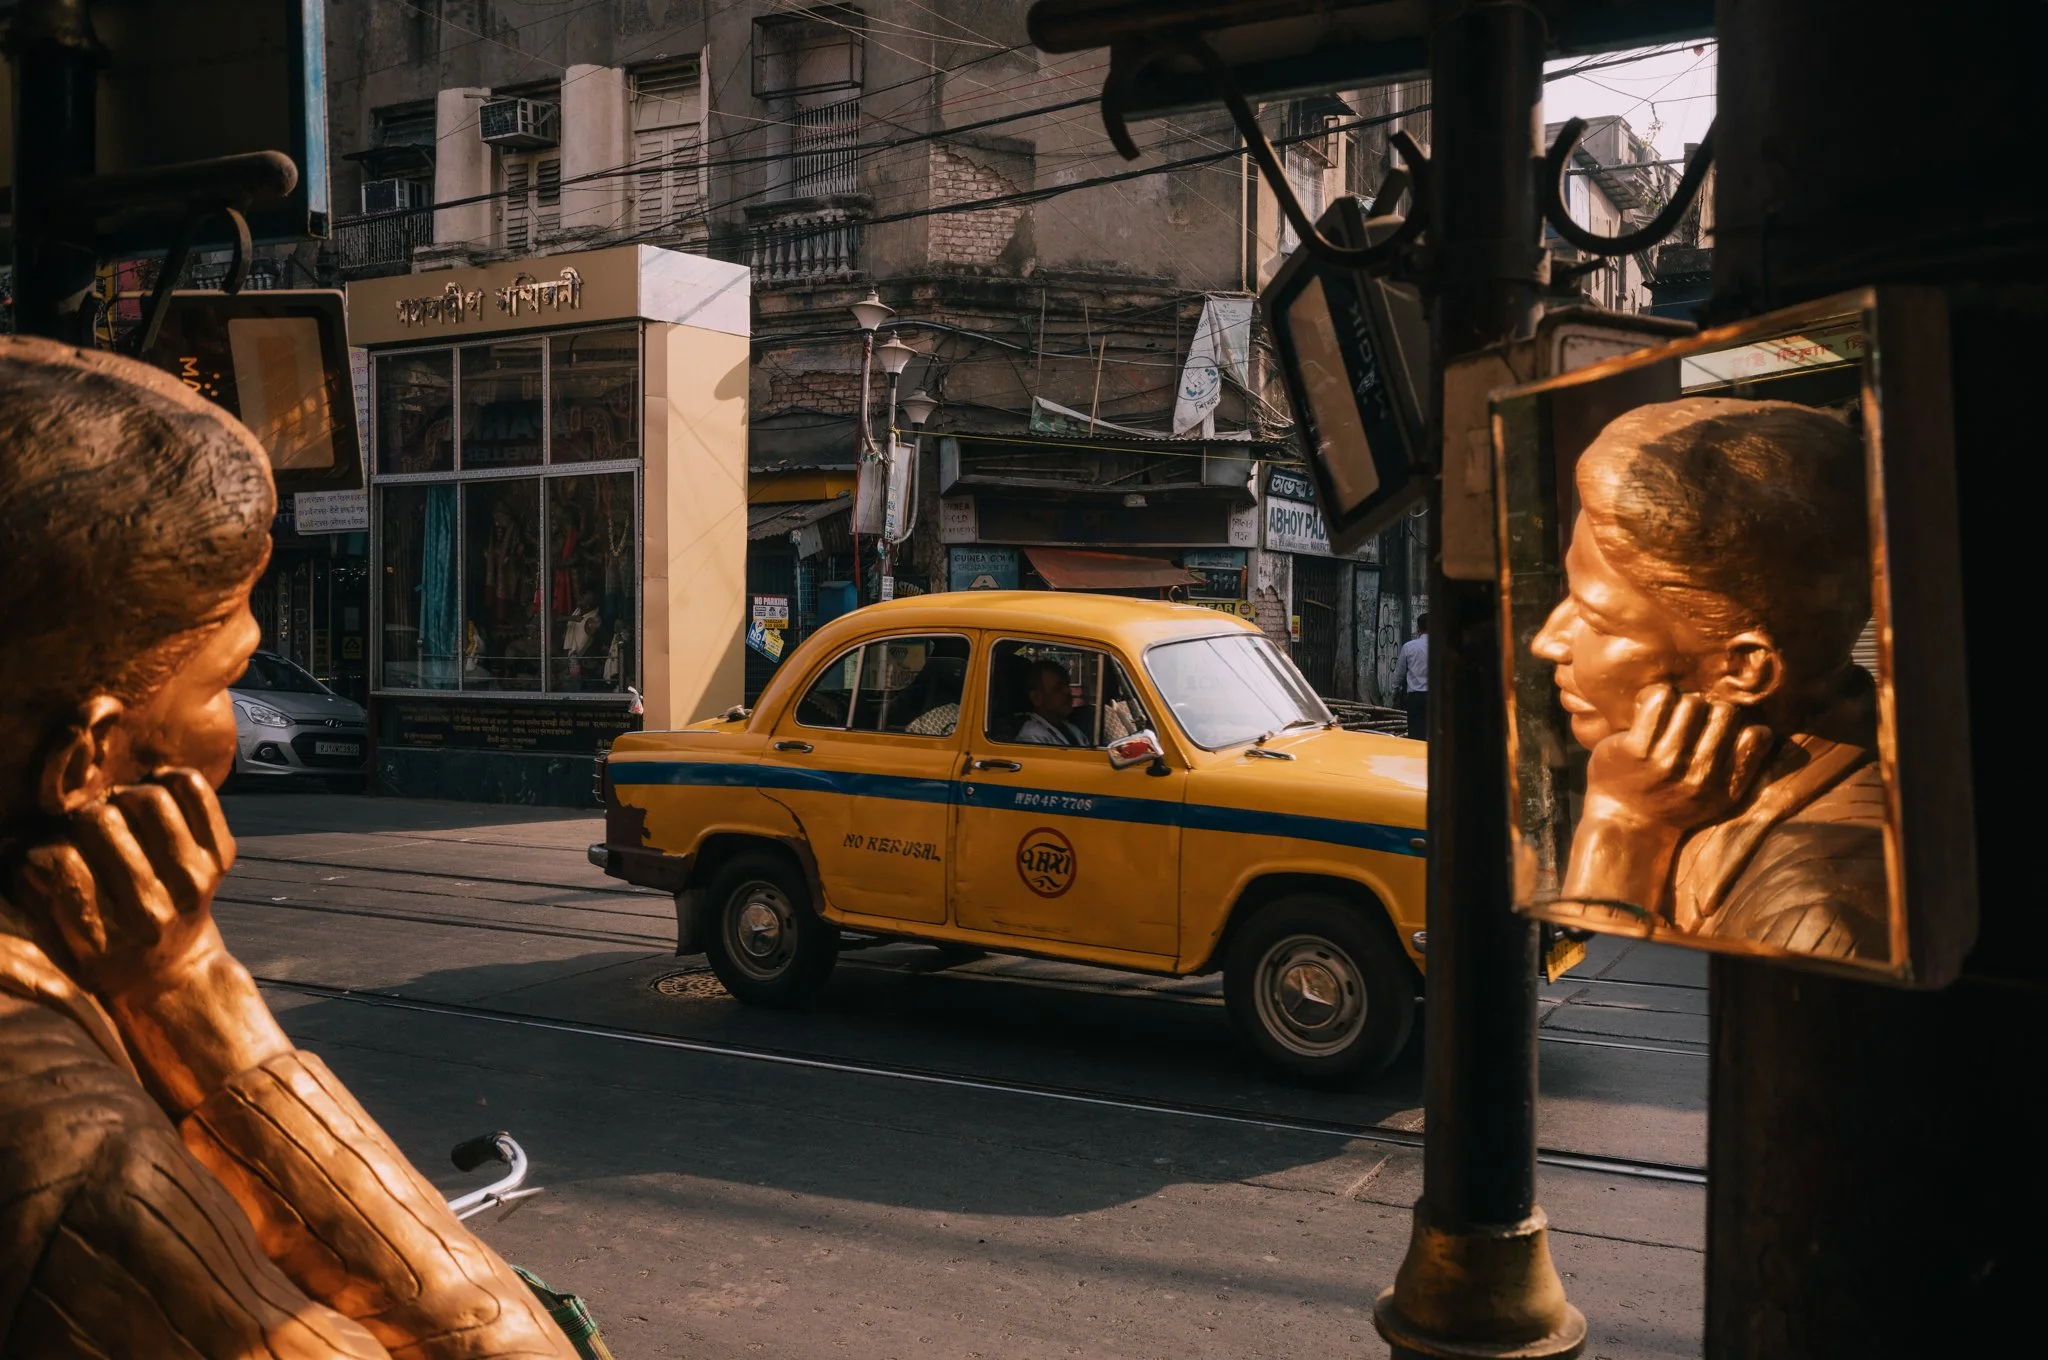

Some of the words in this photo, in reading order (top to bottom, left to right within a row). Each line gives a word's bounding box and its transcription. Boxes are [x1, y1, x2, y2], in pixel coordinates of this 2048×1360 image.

[1269, 506, 1304, 537] ABHOY
[1305, 513, 1329, 541] PAD
[954, 554, 986, 563] GUINEA
[754, 596, 763, 606] NO
[763, 596, 788, 606] PARKING
[843, 832, 864, 849] NO
[867, 836, 942, 862] REFUSAL
